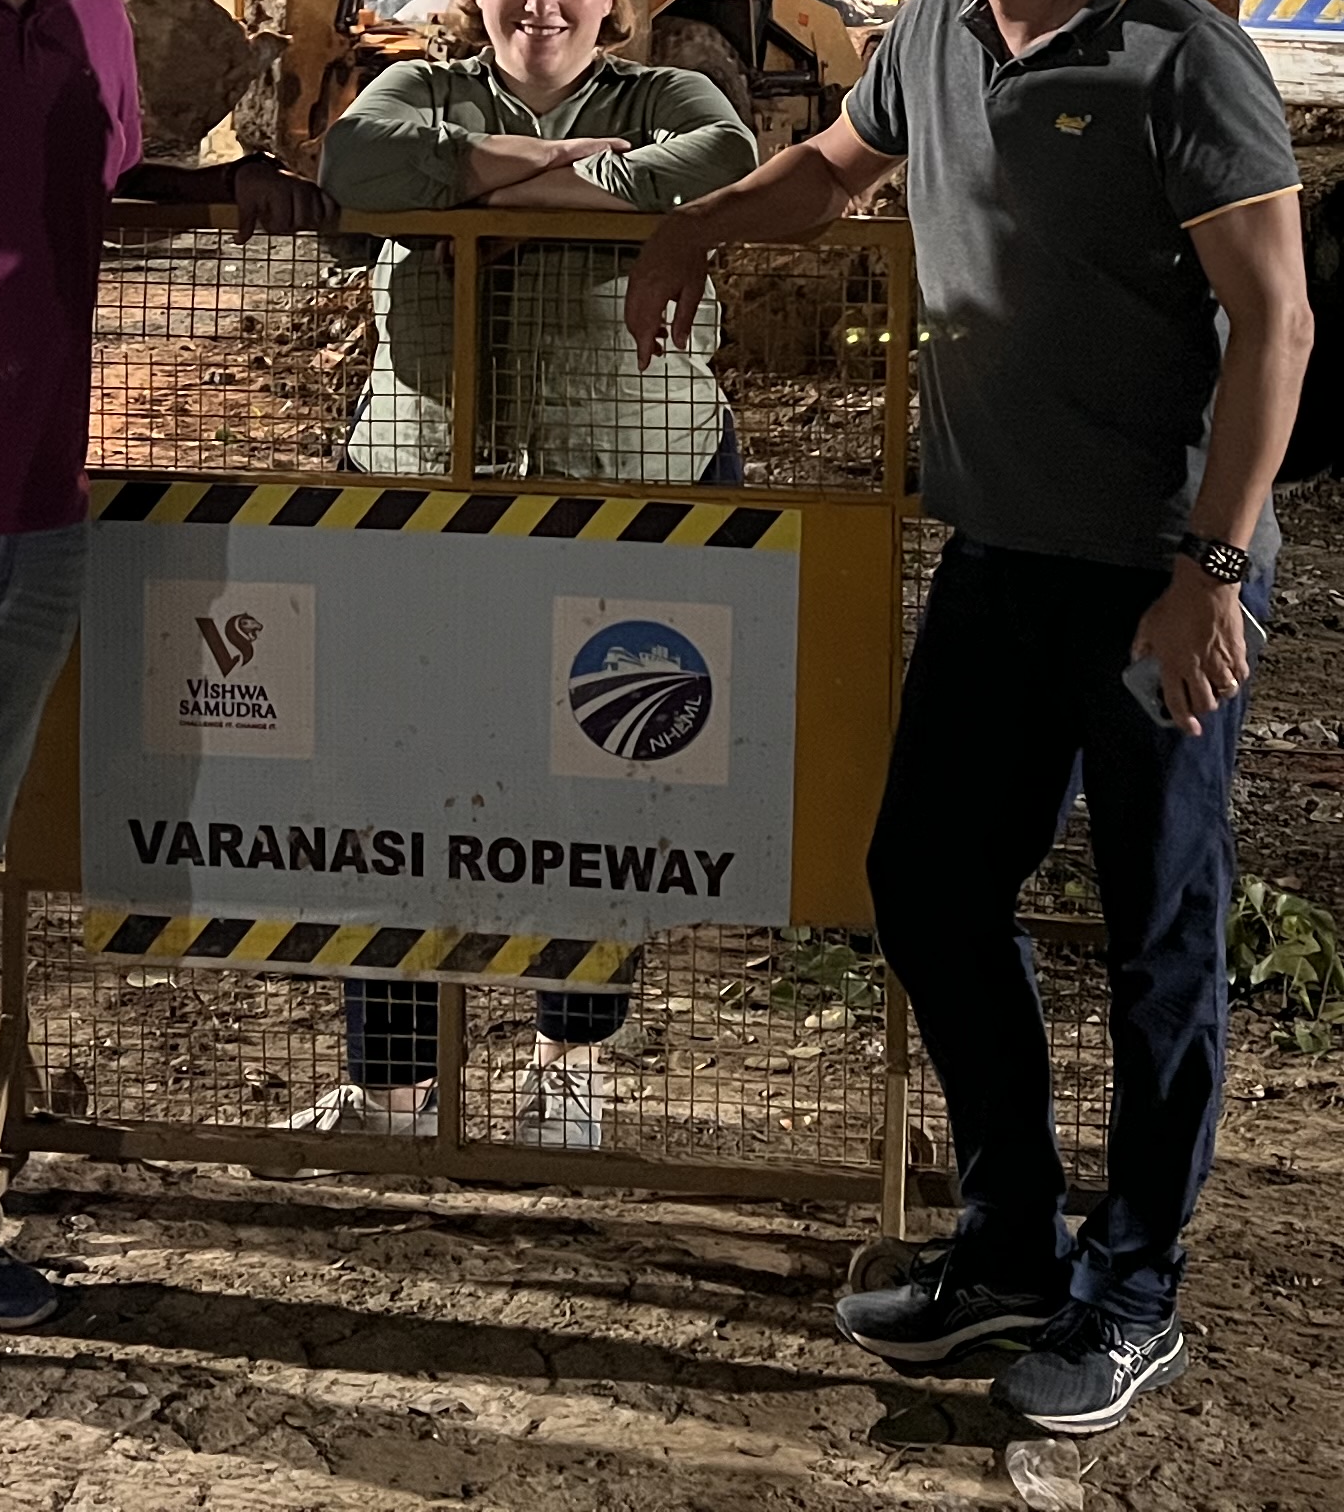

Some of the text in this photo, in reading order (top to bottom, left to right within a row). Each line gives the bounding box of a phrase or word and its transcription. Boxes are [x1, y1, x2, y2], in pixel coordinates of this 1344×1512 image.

[179, 700, 277, 719] SAMUDRA
[186, 678, 269, 701] VISHWA
[649, 695, 702, 753] NHLML
[127, 819, 735, 898] VARANASI ROPEWAY
